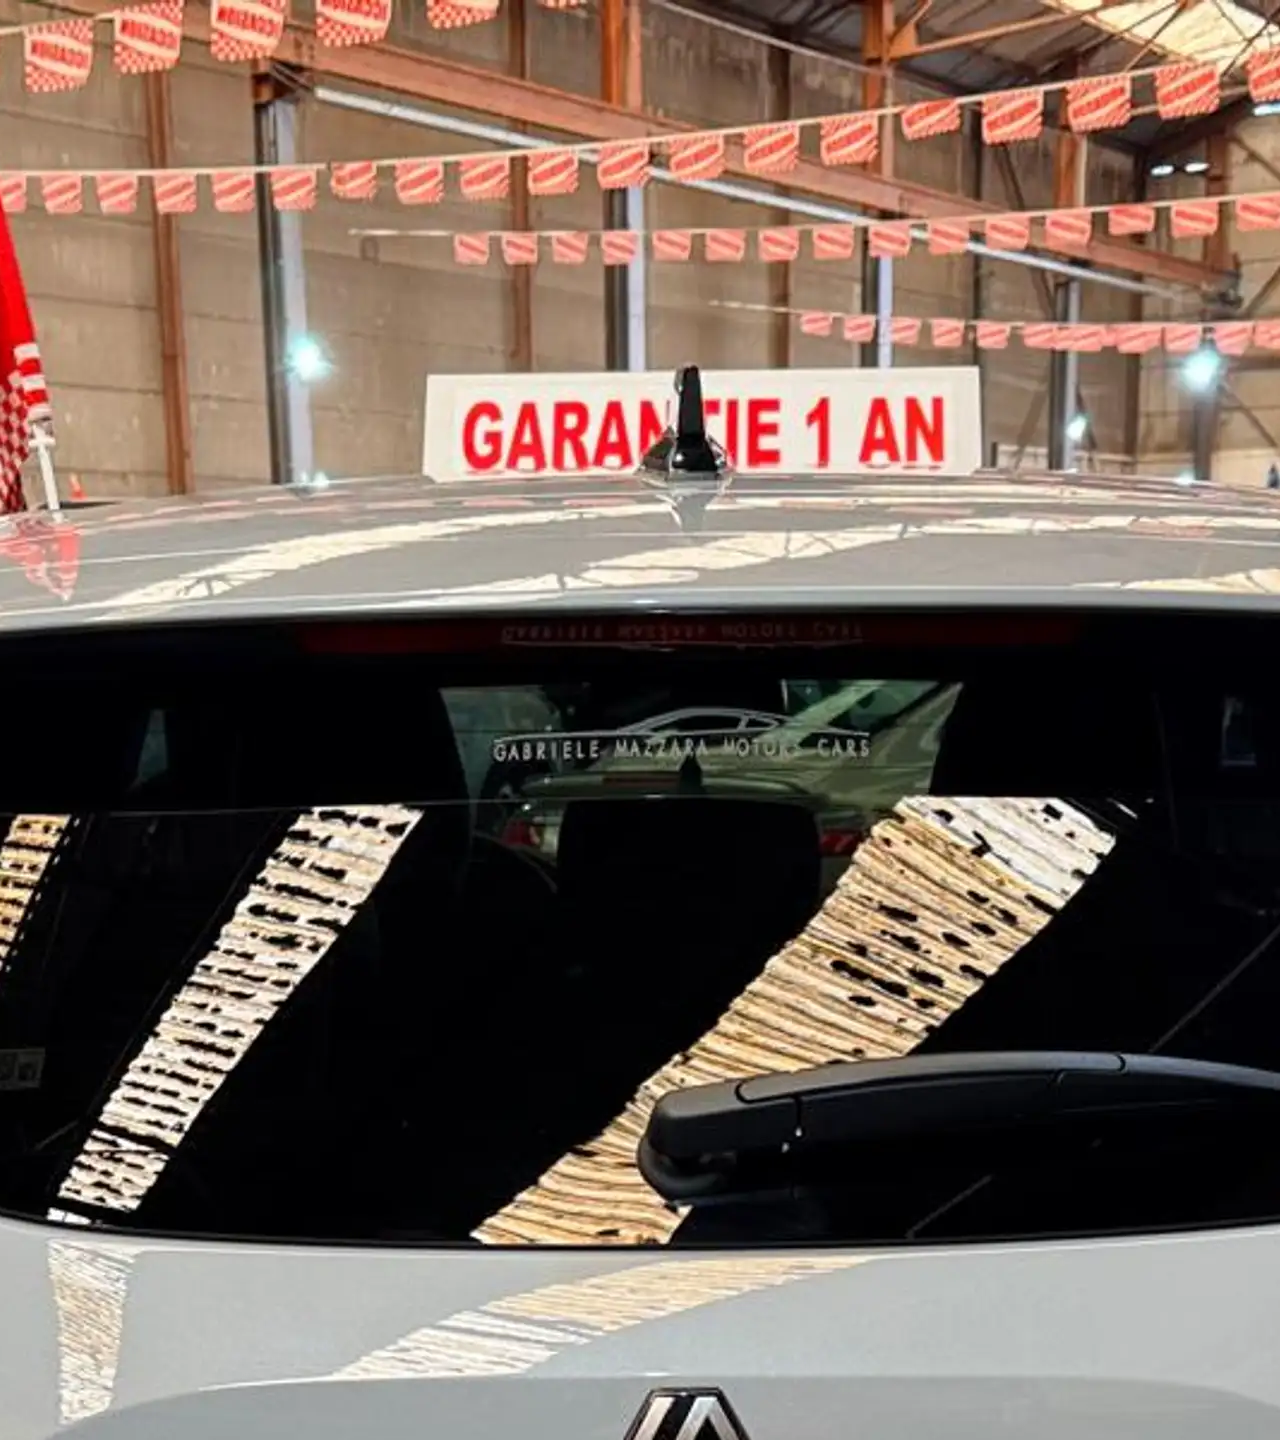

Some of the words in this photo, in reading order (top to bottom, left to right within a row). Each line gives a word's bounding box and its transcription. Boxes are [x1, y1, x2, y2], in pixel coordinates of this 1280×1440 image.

[806, 397, 831, 468] 1
[859, 396, 944, 467] AN
[493, 739, 600, 761] GABRIELE
[613, 738, 708, 758] MAZZARA
[816, 738, 870, 758] CARS
